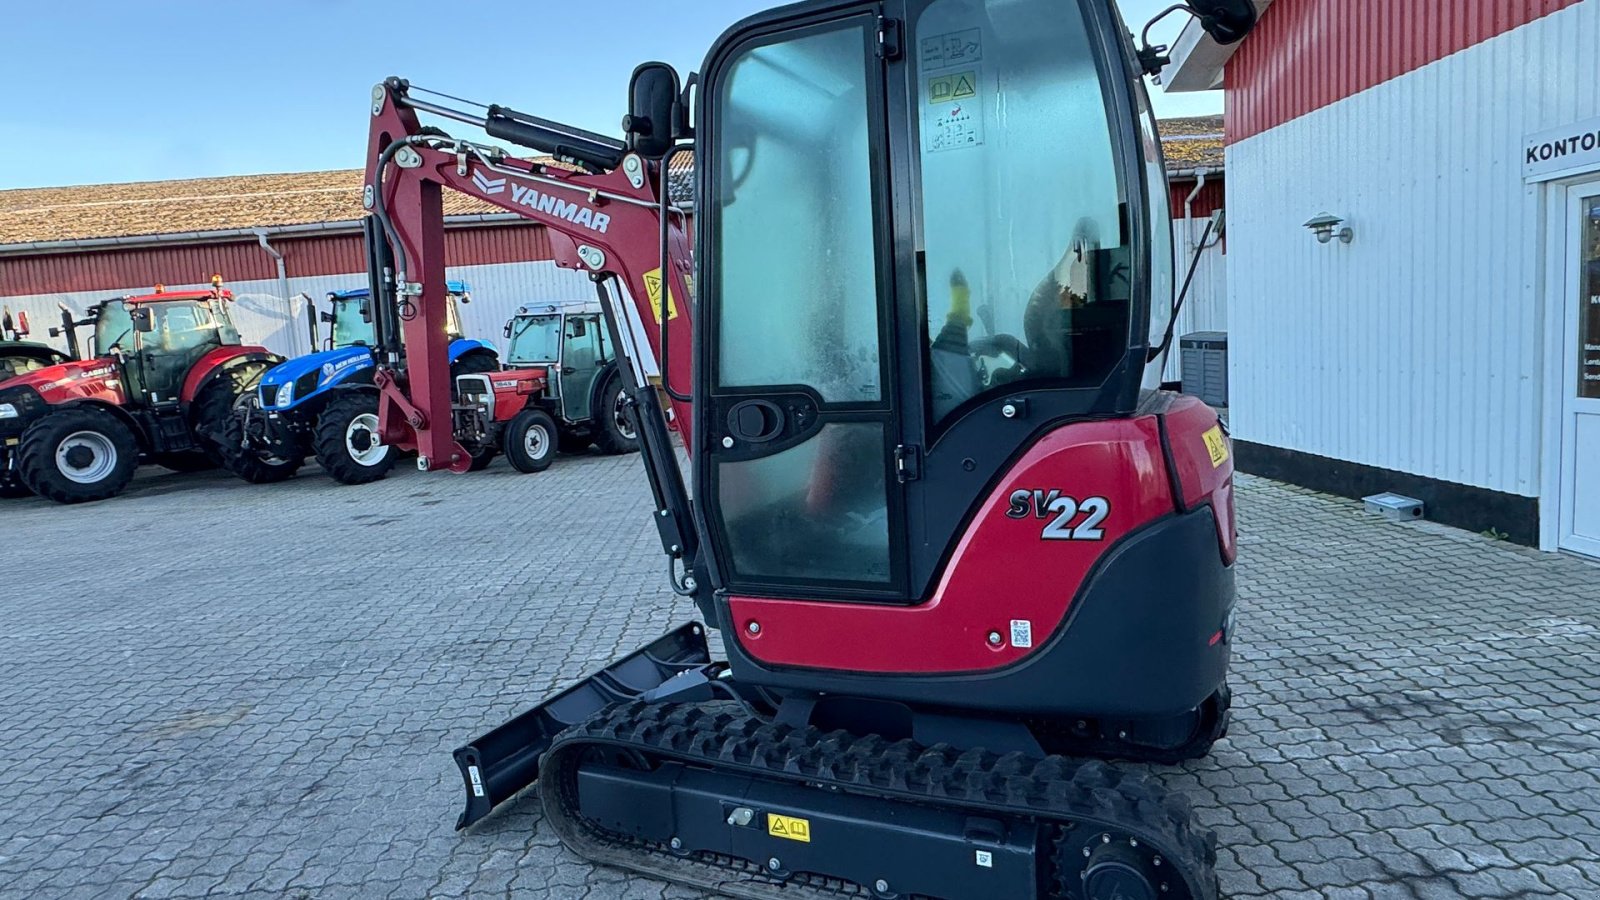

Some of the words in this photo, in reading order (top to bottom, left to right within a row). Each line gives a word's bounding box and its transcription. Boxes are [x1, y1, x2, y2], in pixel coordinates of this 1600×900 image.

[1526, 130, 1600, 164] KONTO
[511, 183, 611, 234] YANMAR
[335, 360, 348, 370] NEW
[348, 353, 370, 365] HOLLAND
